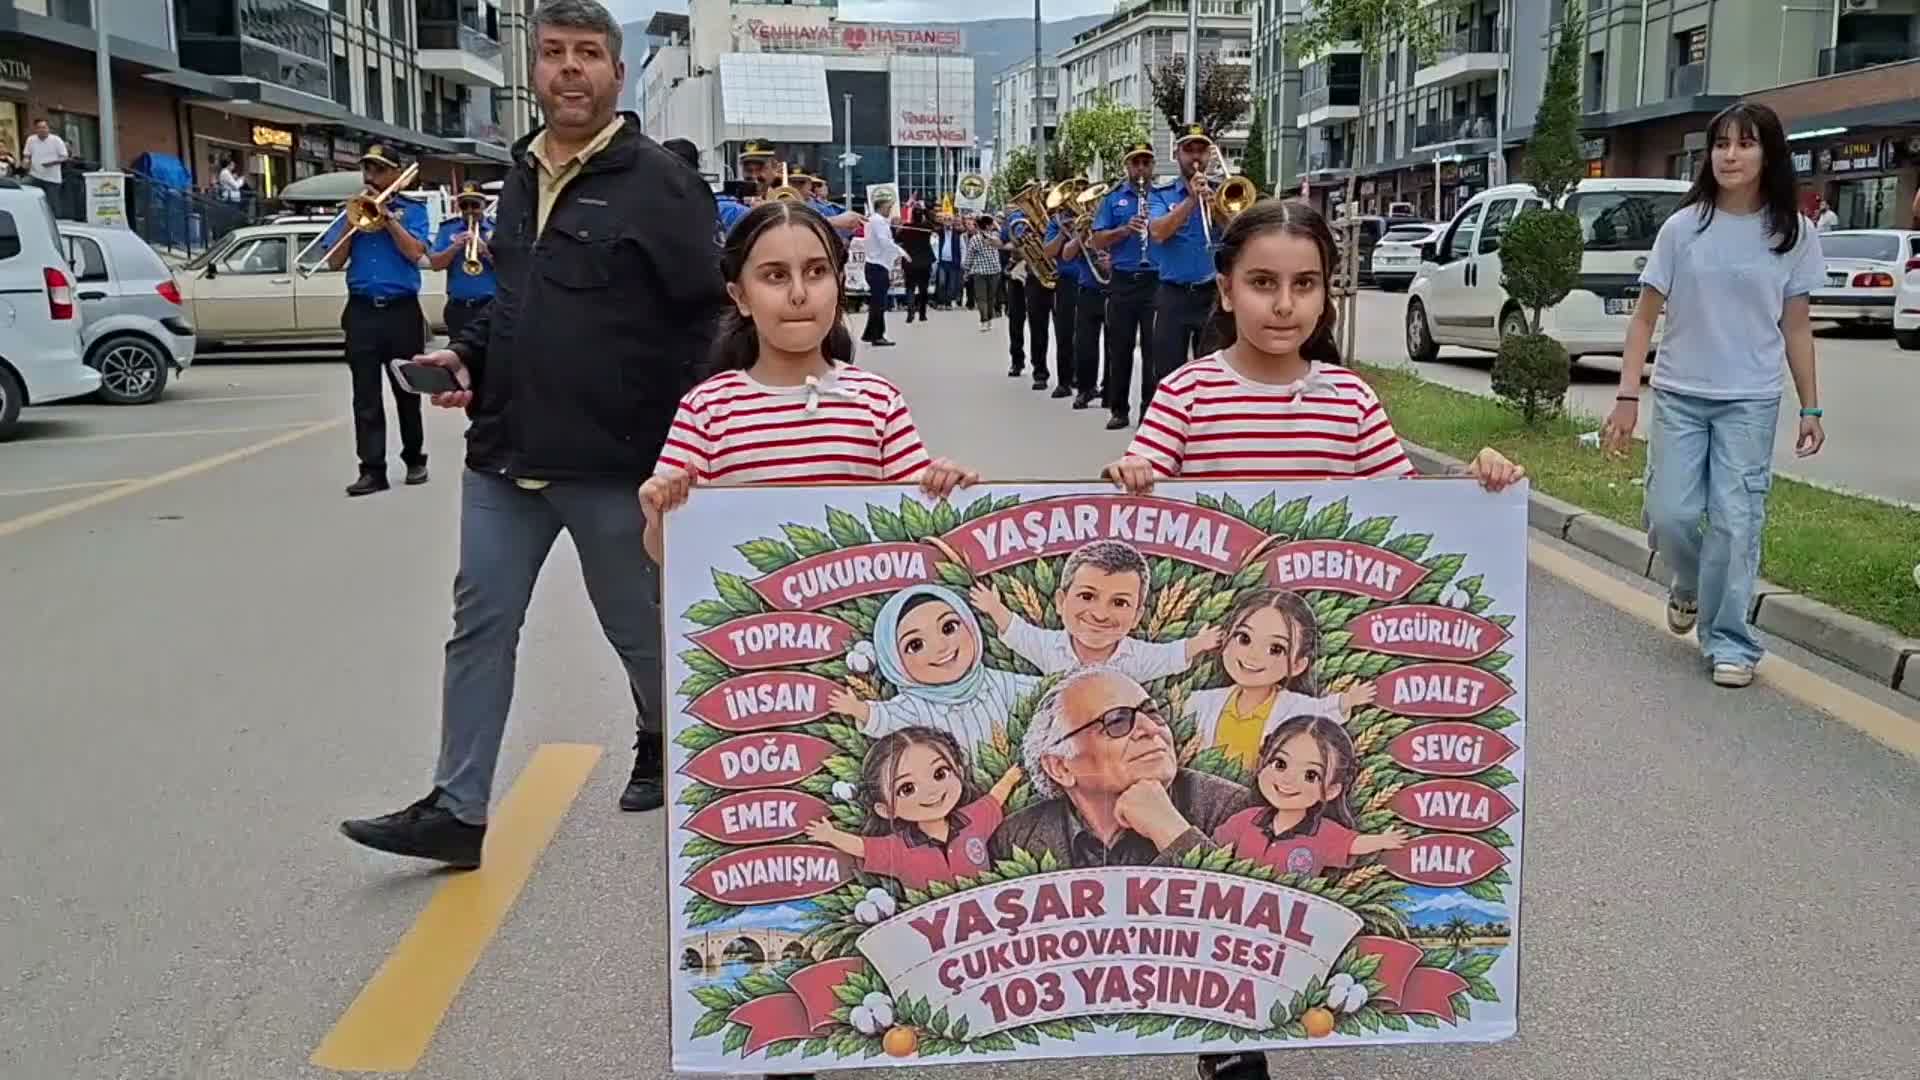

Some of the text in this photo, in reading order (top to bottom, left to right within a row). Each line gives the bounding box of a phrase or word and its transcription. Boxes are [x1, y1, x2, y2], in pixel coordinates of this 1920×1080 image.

[971, 504, 1232, 562] YAŞAR KEMAL
[782, 551, 927, 609] ÇUKUROVA
[1277, 549, 1402, 592] EDEBİYAT
[728, 622, 833, 657] TOPRAK
[1370, 613, 1482, 652] ÖZGÜRLÜK
[724, 683, 816, 721] İNSAN
[1393, 675, 1485, 707] ADALET
[719, 740, 801, 780] DOĞA
[1411, 734, 1483, 765] SEVGİ
[721, 800, 797, 835] EMEK
[1413, 792, 1490, 822] YAYLA
[711, 856, 840, 896] DAYANIŞMA
[1409, 845, 1474, 875] HALK
[908, 877, 1314, 954] YAŞAR KEMAL
[1210, 934, 1286, 977] SESİ
[980, 965, 1257, 1024] 103 YAŞINDA
